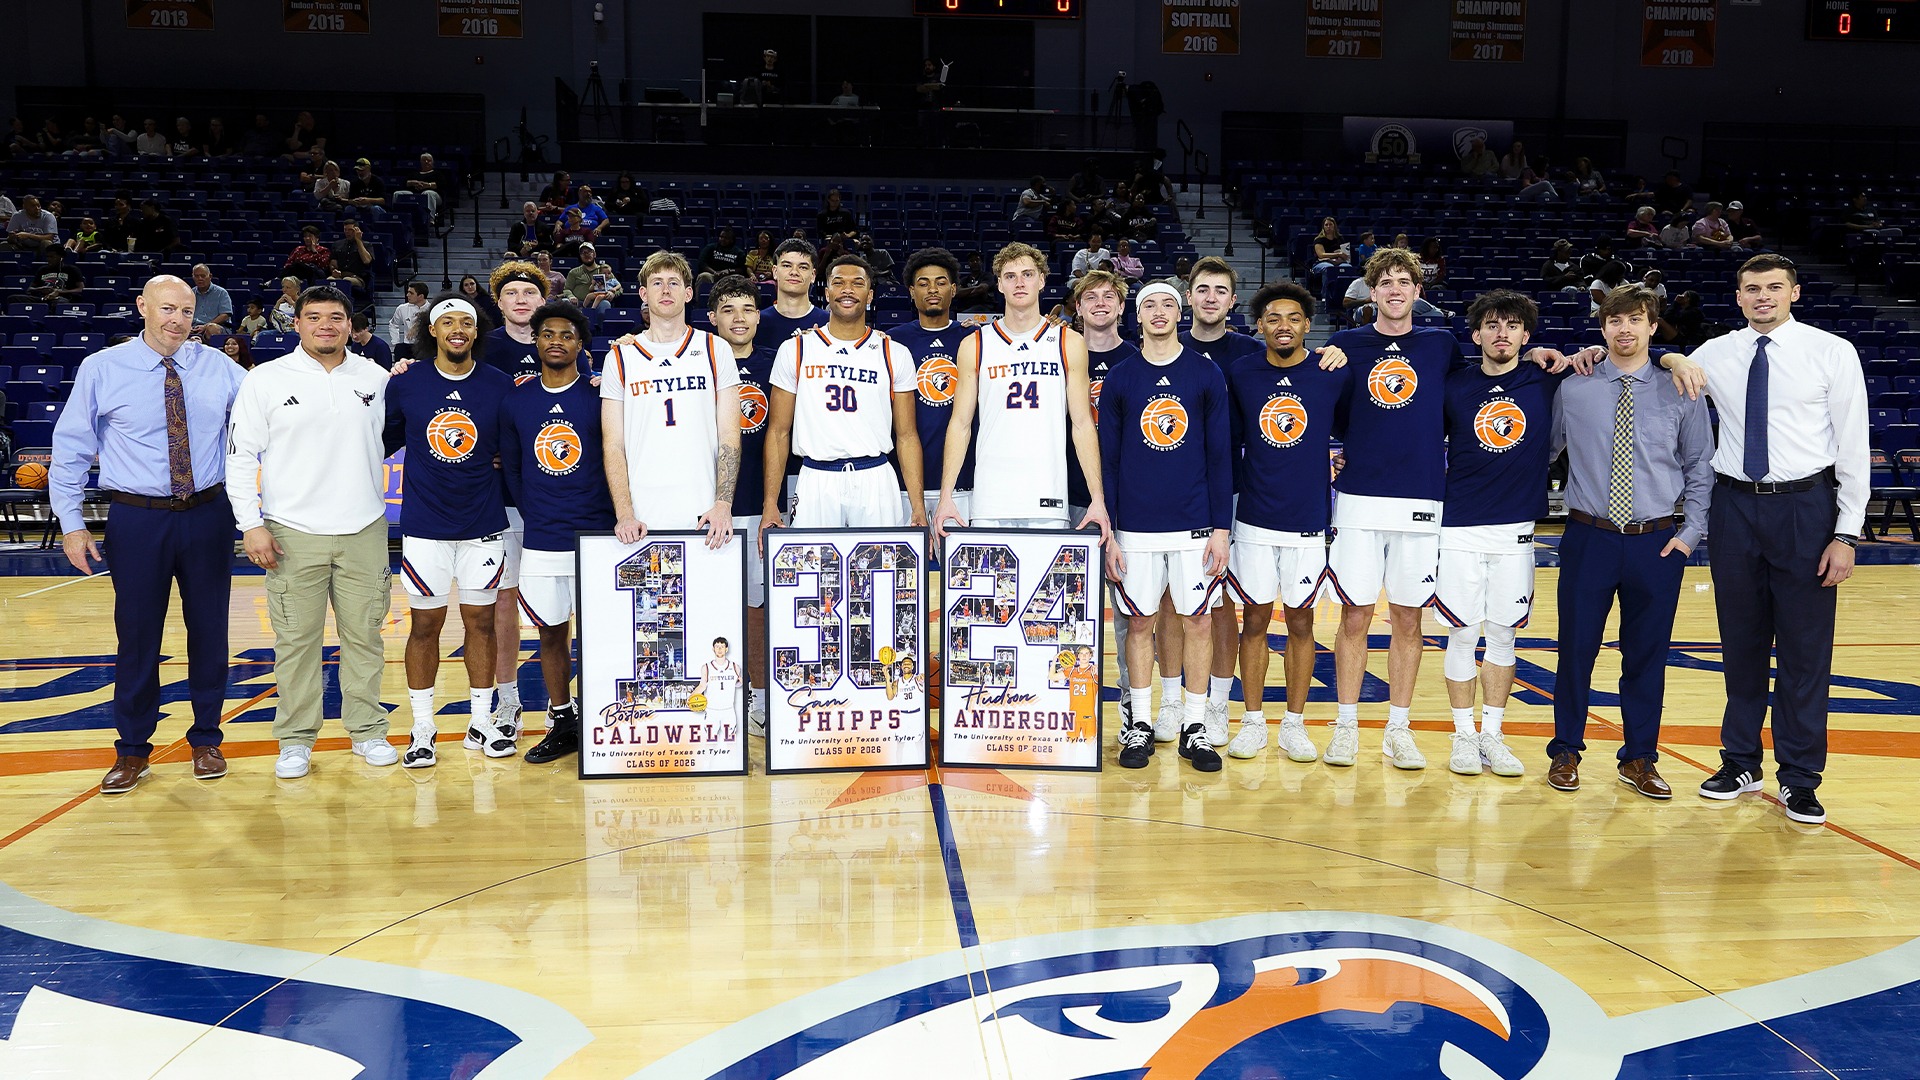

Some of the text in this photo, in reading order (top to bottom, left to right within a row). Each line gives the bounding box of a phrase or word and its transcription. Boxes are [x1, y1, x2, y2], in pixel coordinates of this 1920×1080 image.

[291, 1, 313, 9] Indoor
[315, 2, 335, 10] Track
[1312, 0, 1378, 12] CHAMPION
[1456, 1, 1522, 16] CHAMPION
[1825, 0, 1850, 10] HOME
[150, 9, 189, 27] 2013
[1171, 11, 1232, 28] SOFTBALL
[1645, 6, 1715, 21] CHAMPIONS
[308, 14, 345, 31] 2015
[462, 18, 498, 35] 2016
[1839, 13, 1851, 34] 0
[1183, 35, 1218, 52] 2016
[1328, 40, 1361, 56] 2017
[1473, 44, 1504, 60] 2017
[1662, 49, 1694, 65] 2018
[1382, 138, 1405, 156] 50
[932, 353, 953, 361] TYLER
[1387, 355, 1410, 363] TYLER
[805, 364, 878, 385] UT TYLER
[987, 361, 1060, 380] UT TYLER
[629, 376, 707, 397] UT TYLER
[825, 384, 858, 413] 30
[918, 396, 954, 407] BASKETBA
[1006, 381, 1039, 409] 24
[1159, 393, 1181, 402] TYLER
[1280, 391, 1302, 401] TYLER
[1370, 397, 1414, 409] BASKETBALL
[448, 406, 471, 417] TYLER
[664, 398, 677, 427] 1
[552, 419, 574, 428] TYLER
[1143, 439, 1185, 452] BASKETBALL
[1260, 434, 1303, 448] BASKETBALL
[31, 454, 52, 462] TYLE
[429, 449, 473, 464] BASKETBALL
[537, 463, 580, 476] BASKETBALL
[904, 692, 913, 700] 30
[961, 681, 1037, 711] Hudson
[1073, 684, 1088, 696] 24
[787, 685, 850, 716] Sam
[599, 699, 658, 728] Boston
[797, 709, 902, 732] PHIPPS
[954, 709, 1076, 731] ANDERSON
[593, 724, 737, 745] CALDWELL
[798, 736, 842, 745] University
[857, 735, 880, 743] Texas
[895, 735, 916, 743] Tyler
[971, 734, 1014, 742] University
[609, 748, 654, 758] University
[669, 749, 693, 757] Texas
[709, 748, 731, 756] Tyler
[814, 746, 882, 756] CLASS OF 2026
[986, 743, 1053, 753] CLASS OF 2026
[626, 759, 696, 769] CLASS OF 2026
